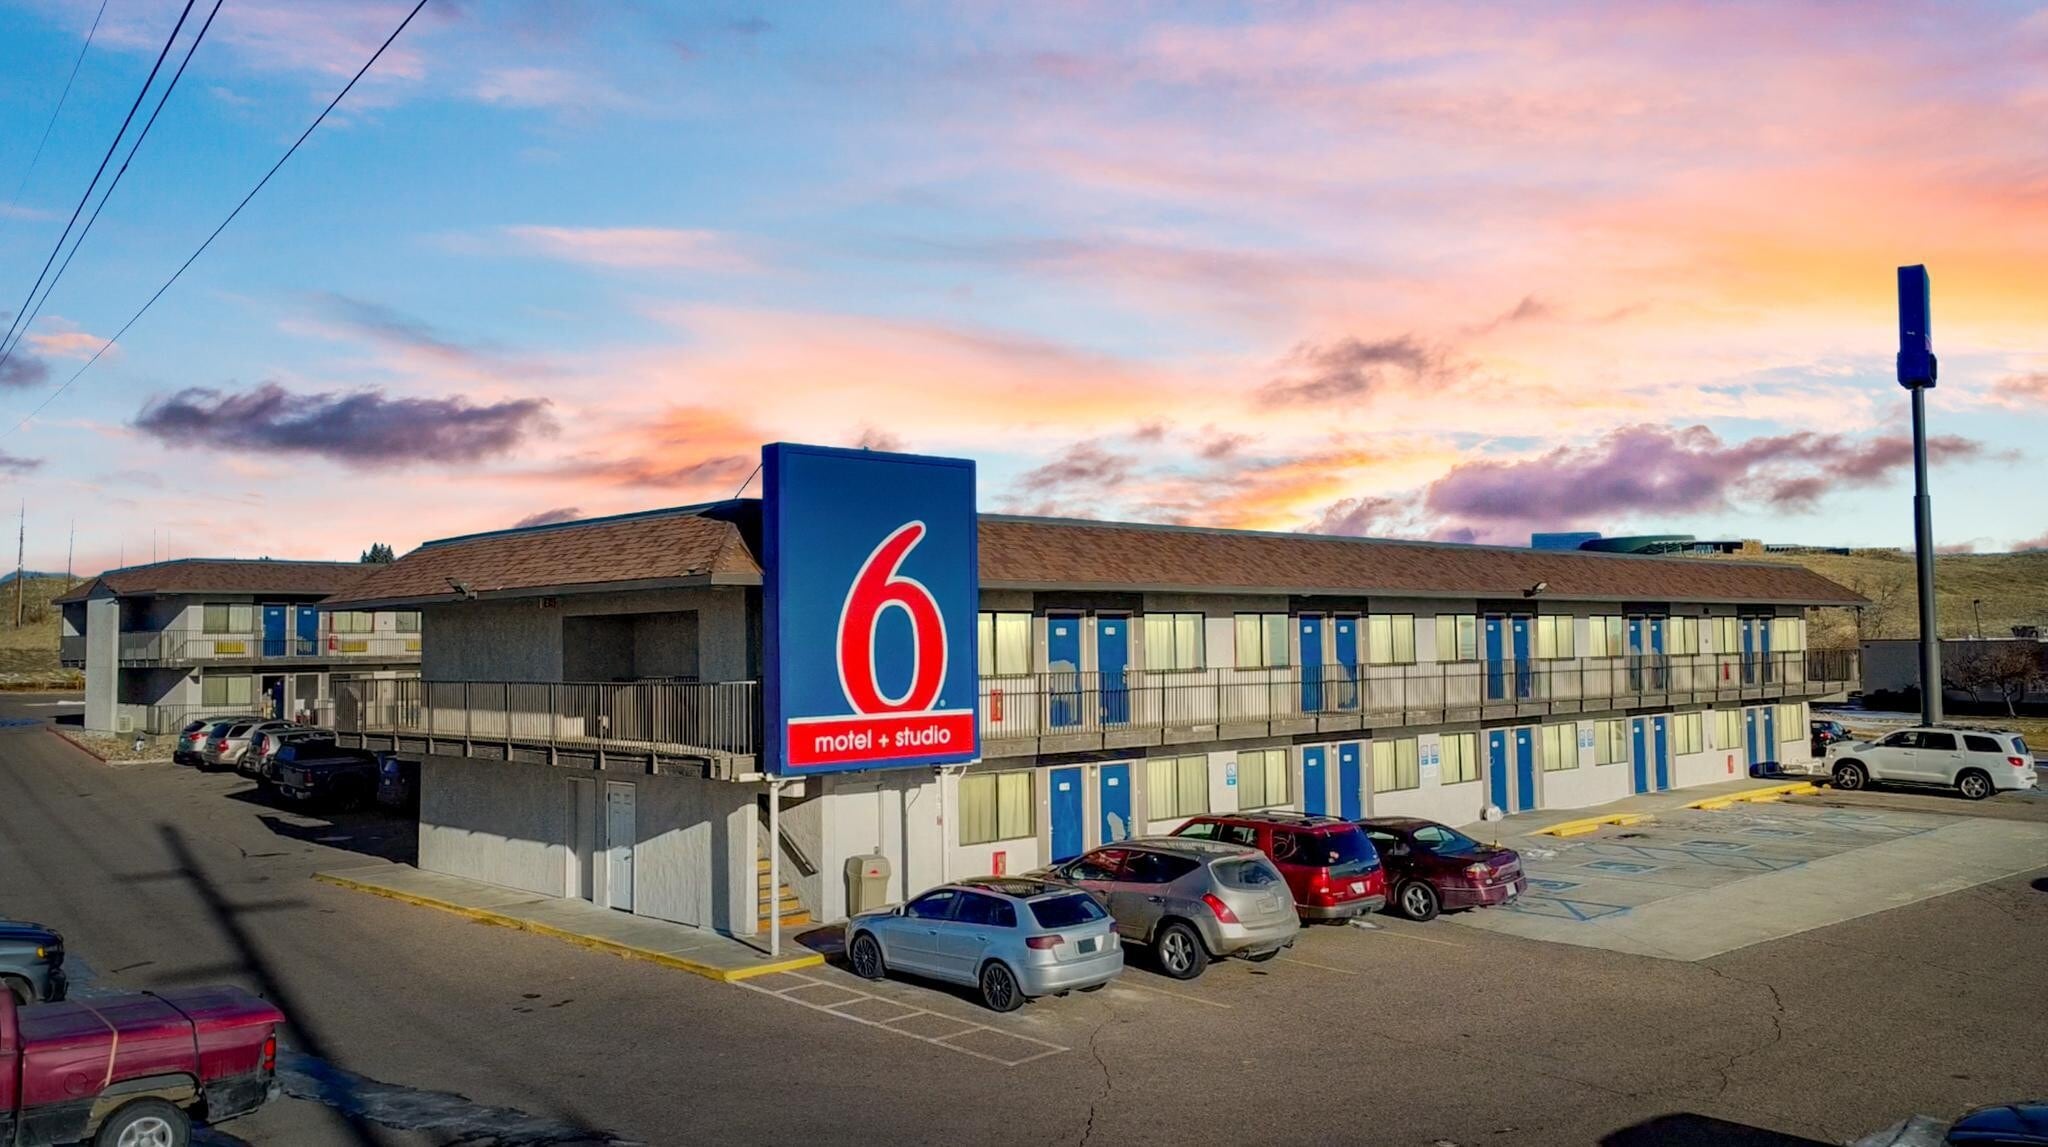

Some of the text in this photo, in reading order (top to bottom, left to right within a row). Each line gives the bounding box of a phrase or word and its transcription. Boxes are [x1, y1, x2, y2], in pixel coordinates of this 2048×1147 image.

[836, 520, 948, 715] 6
[815, 729, 872, 753] motel
[895, 725, 951, 746] studio
